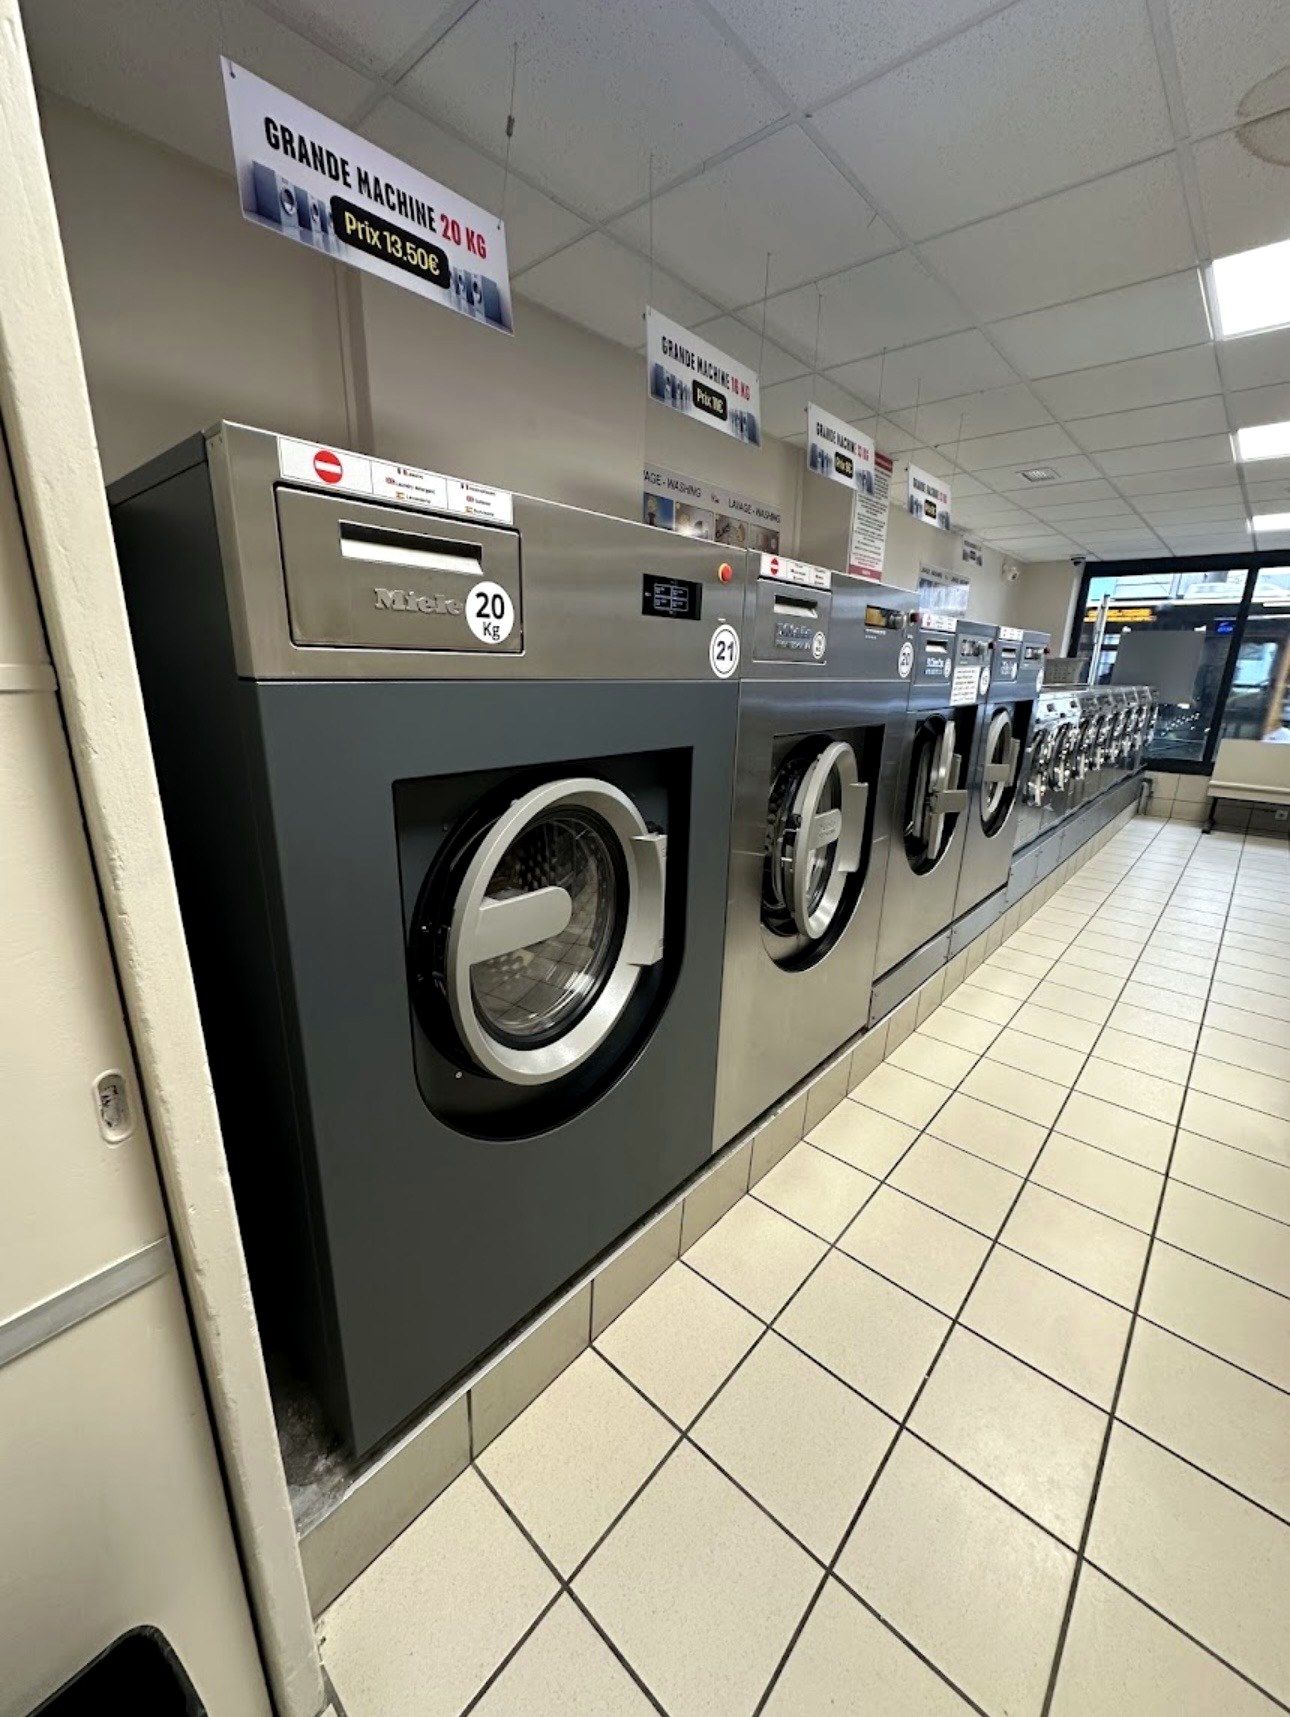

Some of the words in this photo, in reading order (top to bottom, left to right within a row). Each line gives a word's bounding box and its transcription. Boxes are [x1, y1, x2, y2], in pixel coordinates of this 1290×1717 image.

[264, 116, 352, 188] GRANDE
[357, 166, 437, 233] MACHINE
[440, 213, 461, 246] 20
[467, 229, 487, 260] KG
[344, 211, 382, 250] Prix
[383, 229, 440, 276] 13.50€
[661, 335, 695, 370] GRANDE
[697, 355, 730, 389] MACHINE
[667, 478, 702, 498] WASHING
[728, 497, 752, 515] LAVAGE
[755, 508, 781, 524] WASHING
[375, 587, 463, 616] Miele
[475, 591, 505, 620] 20
[482, 621, 501, 640] Kg
[716, 640, 734, 662] 21
